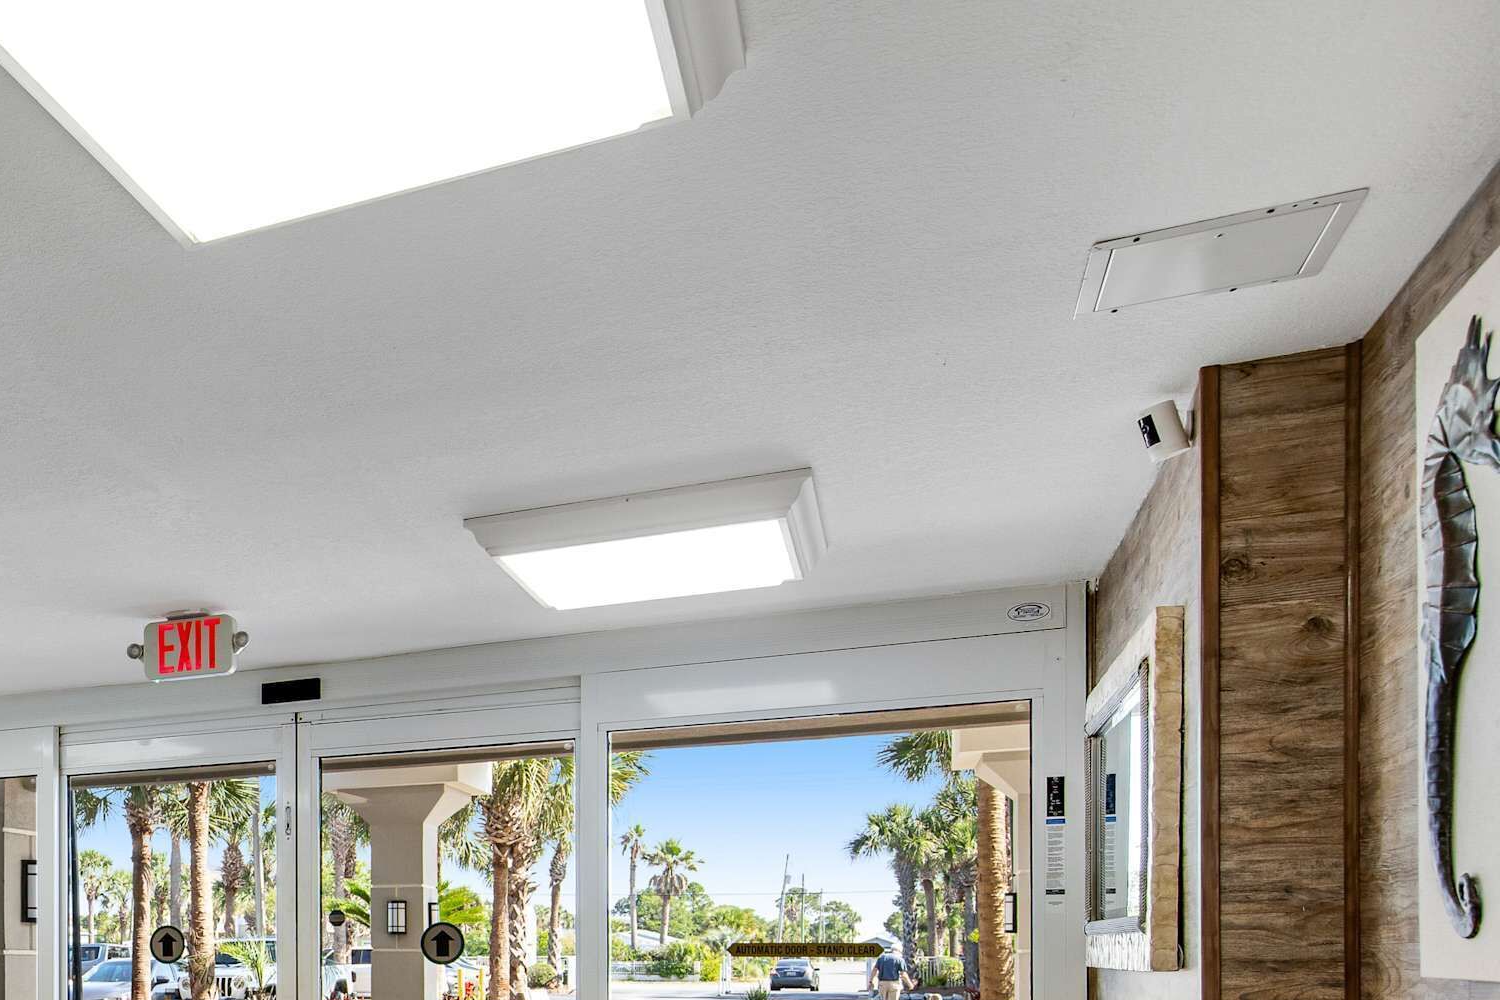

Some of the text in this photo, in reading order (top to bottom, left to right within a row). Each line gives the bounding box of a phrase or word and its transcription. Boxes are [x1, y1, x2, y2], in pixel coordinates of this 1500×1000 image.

[158, 617, 221, 674] EXIT
[736, 945, 783, 955] AUTOMATIC
[785, 945, 807, 955] DOOR
[817, 945, 845, 955] STAND
[847, 945, 875, 955] CLEAR
